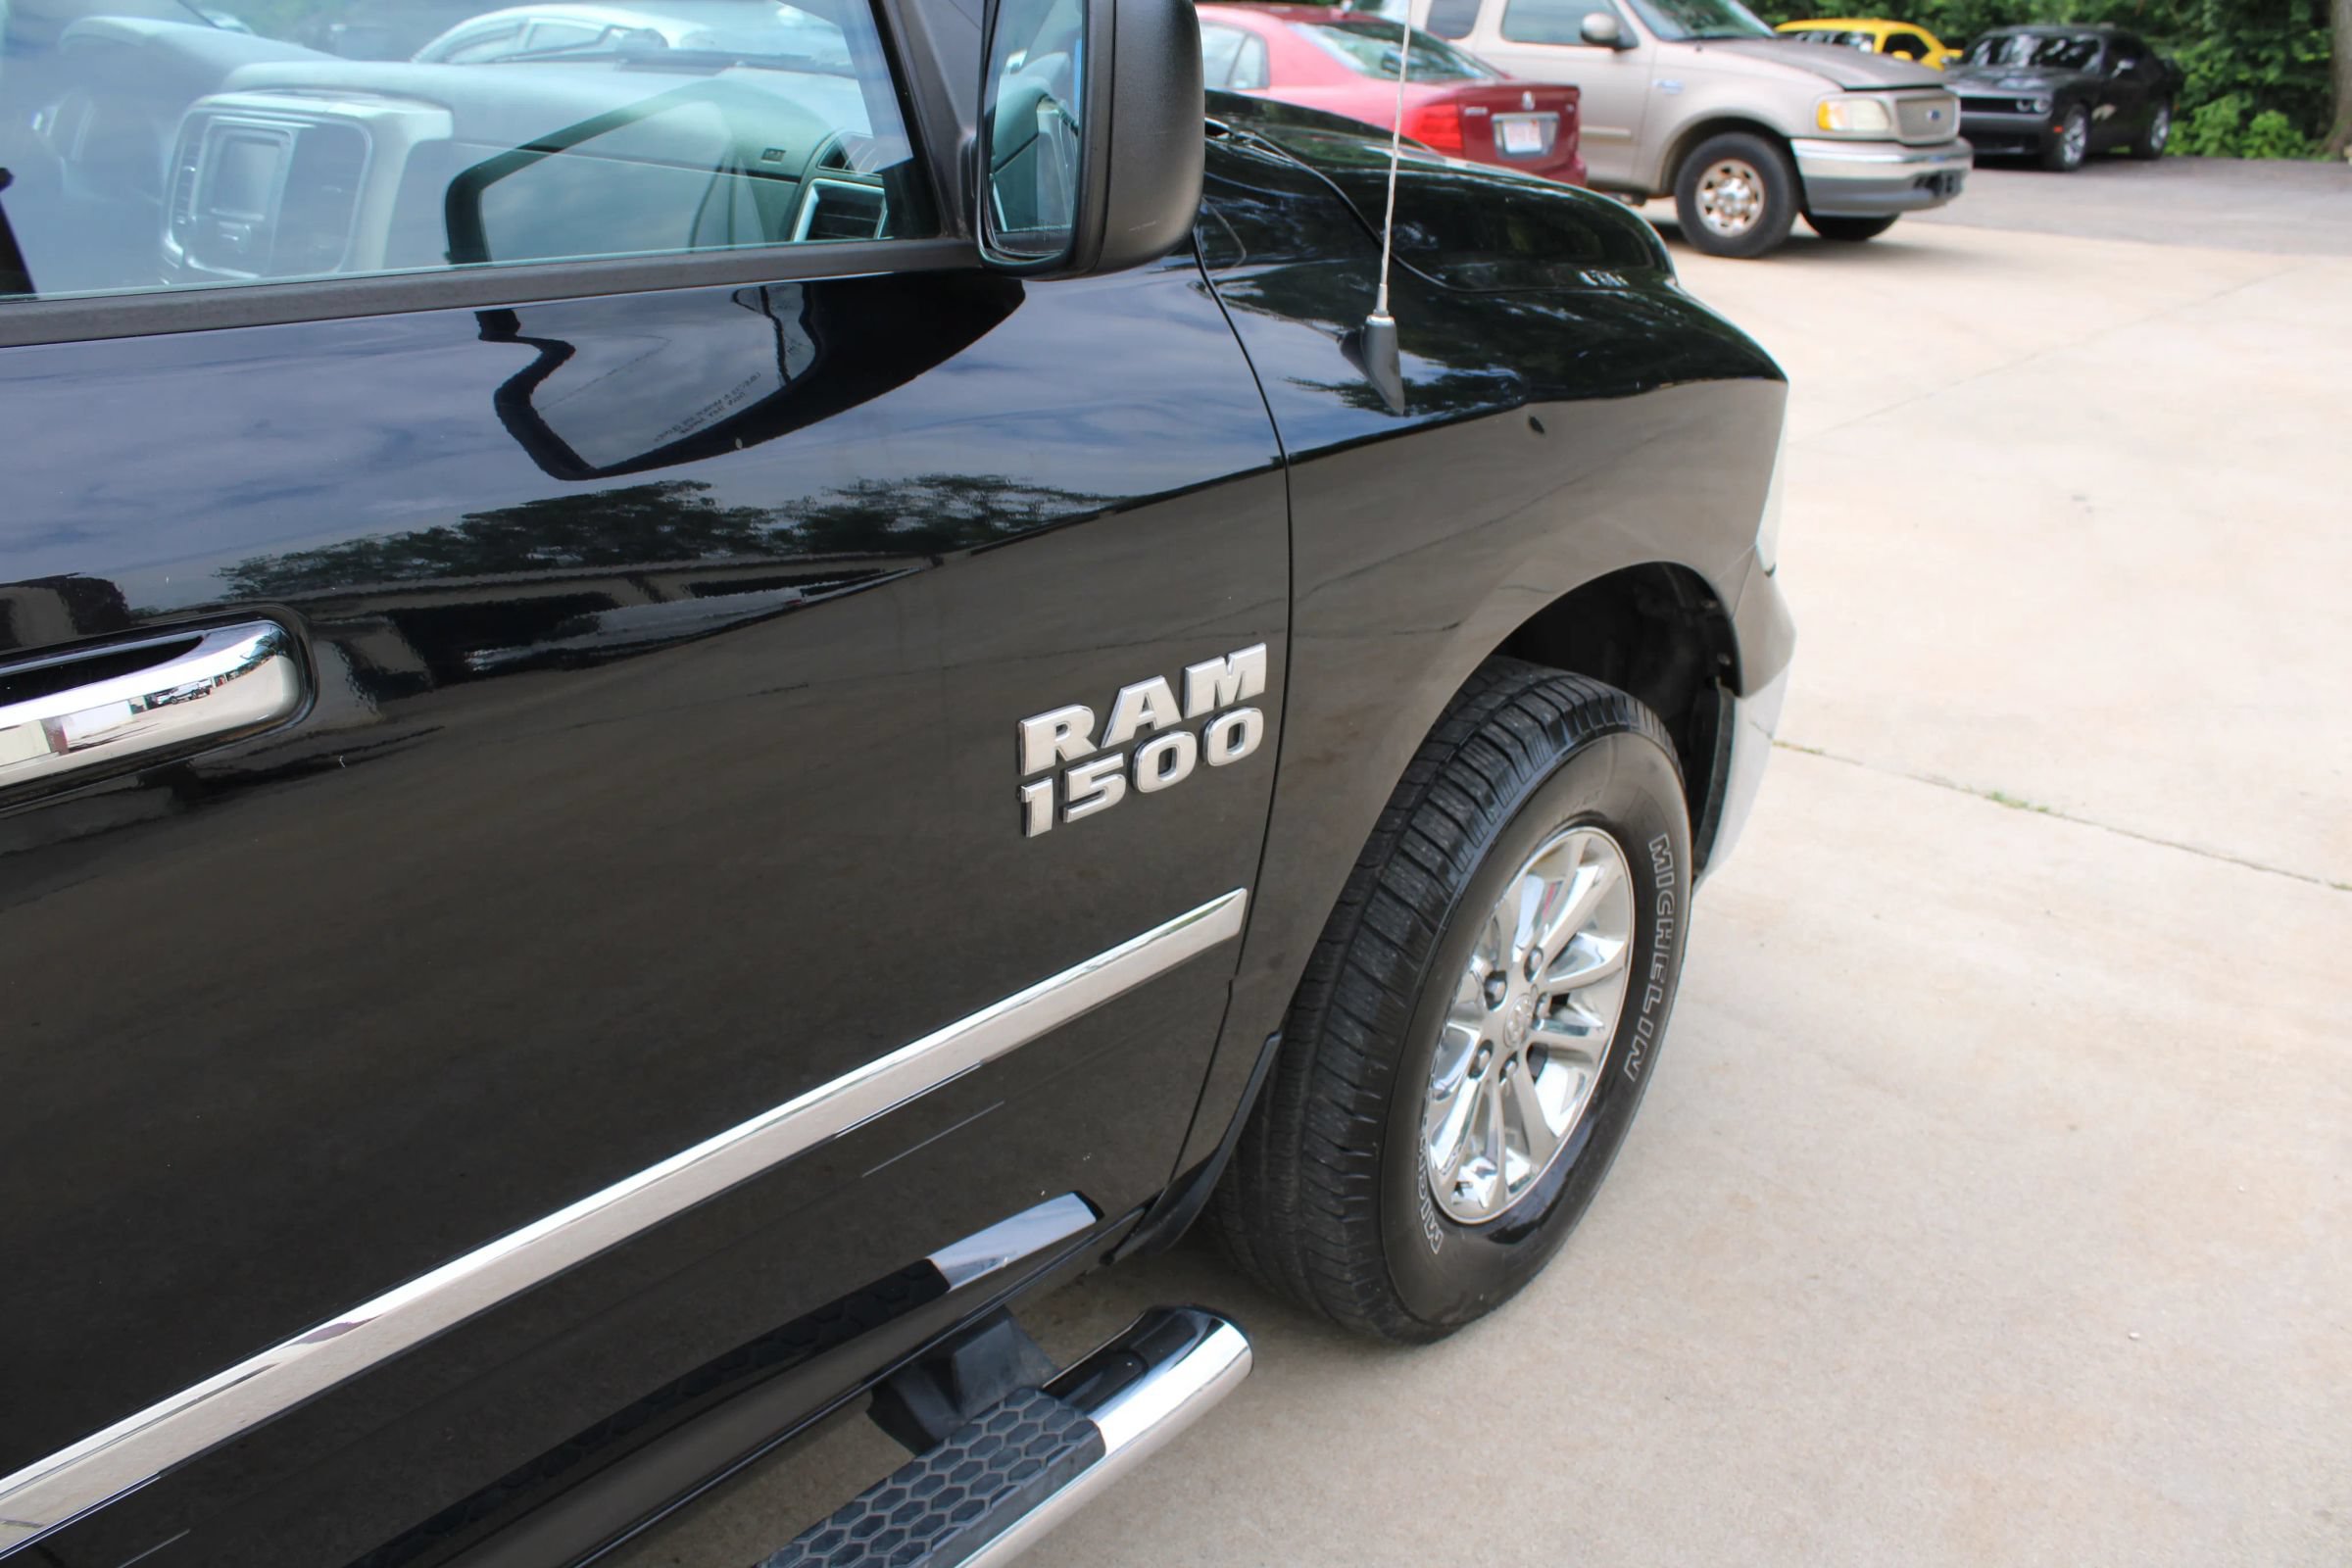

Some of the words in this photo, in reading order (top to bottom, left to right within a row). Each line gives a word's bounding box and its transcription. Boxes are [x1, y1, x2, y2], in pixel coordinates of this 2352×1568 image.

[1018, 642, 1267, 776] RAM
[1019, 706, 1265, 839] 1500
[1623, 833, 1676, 1083] MICHELIN
